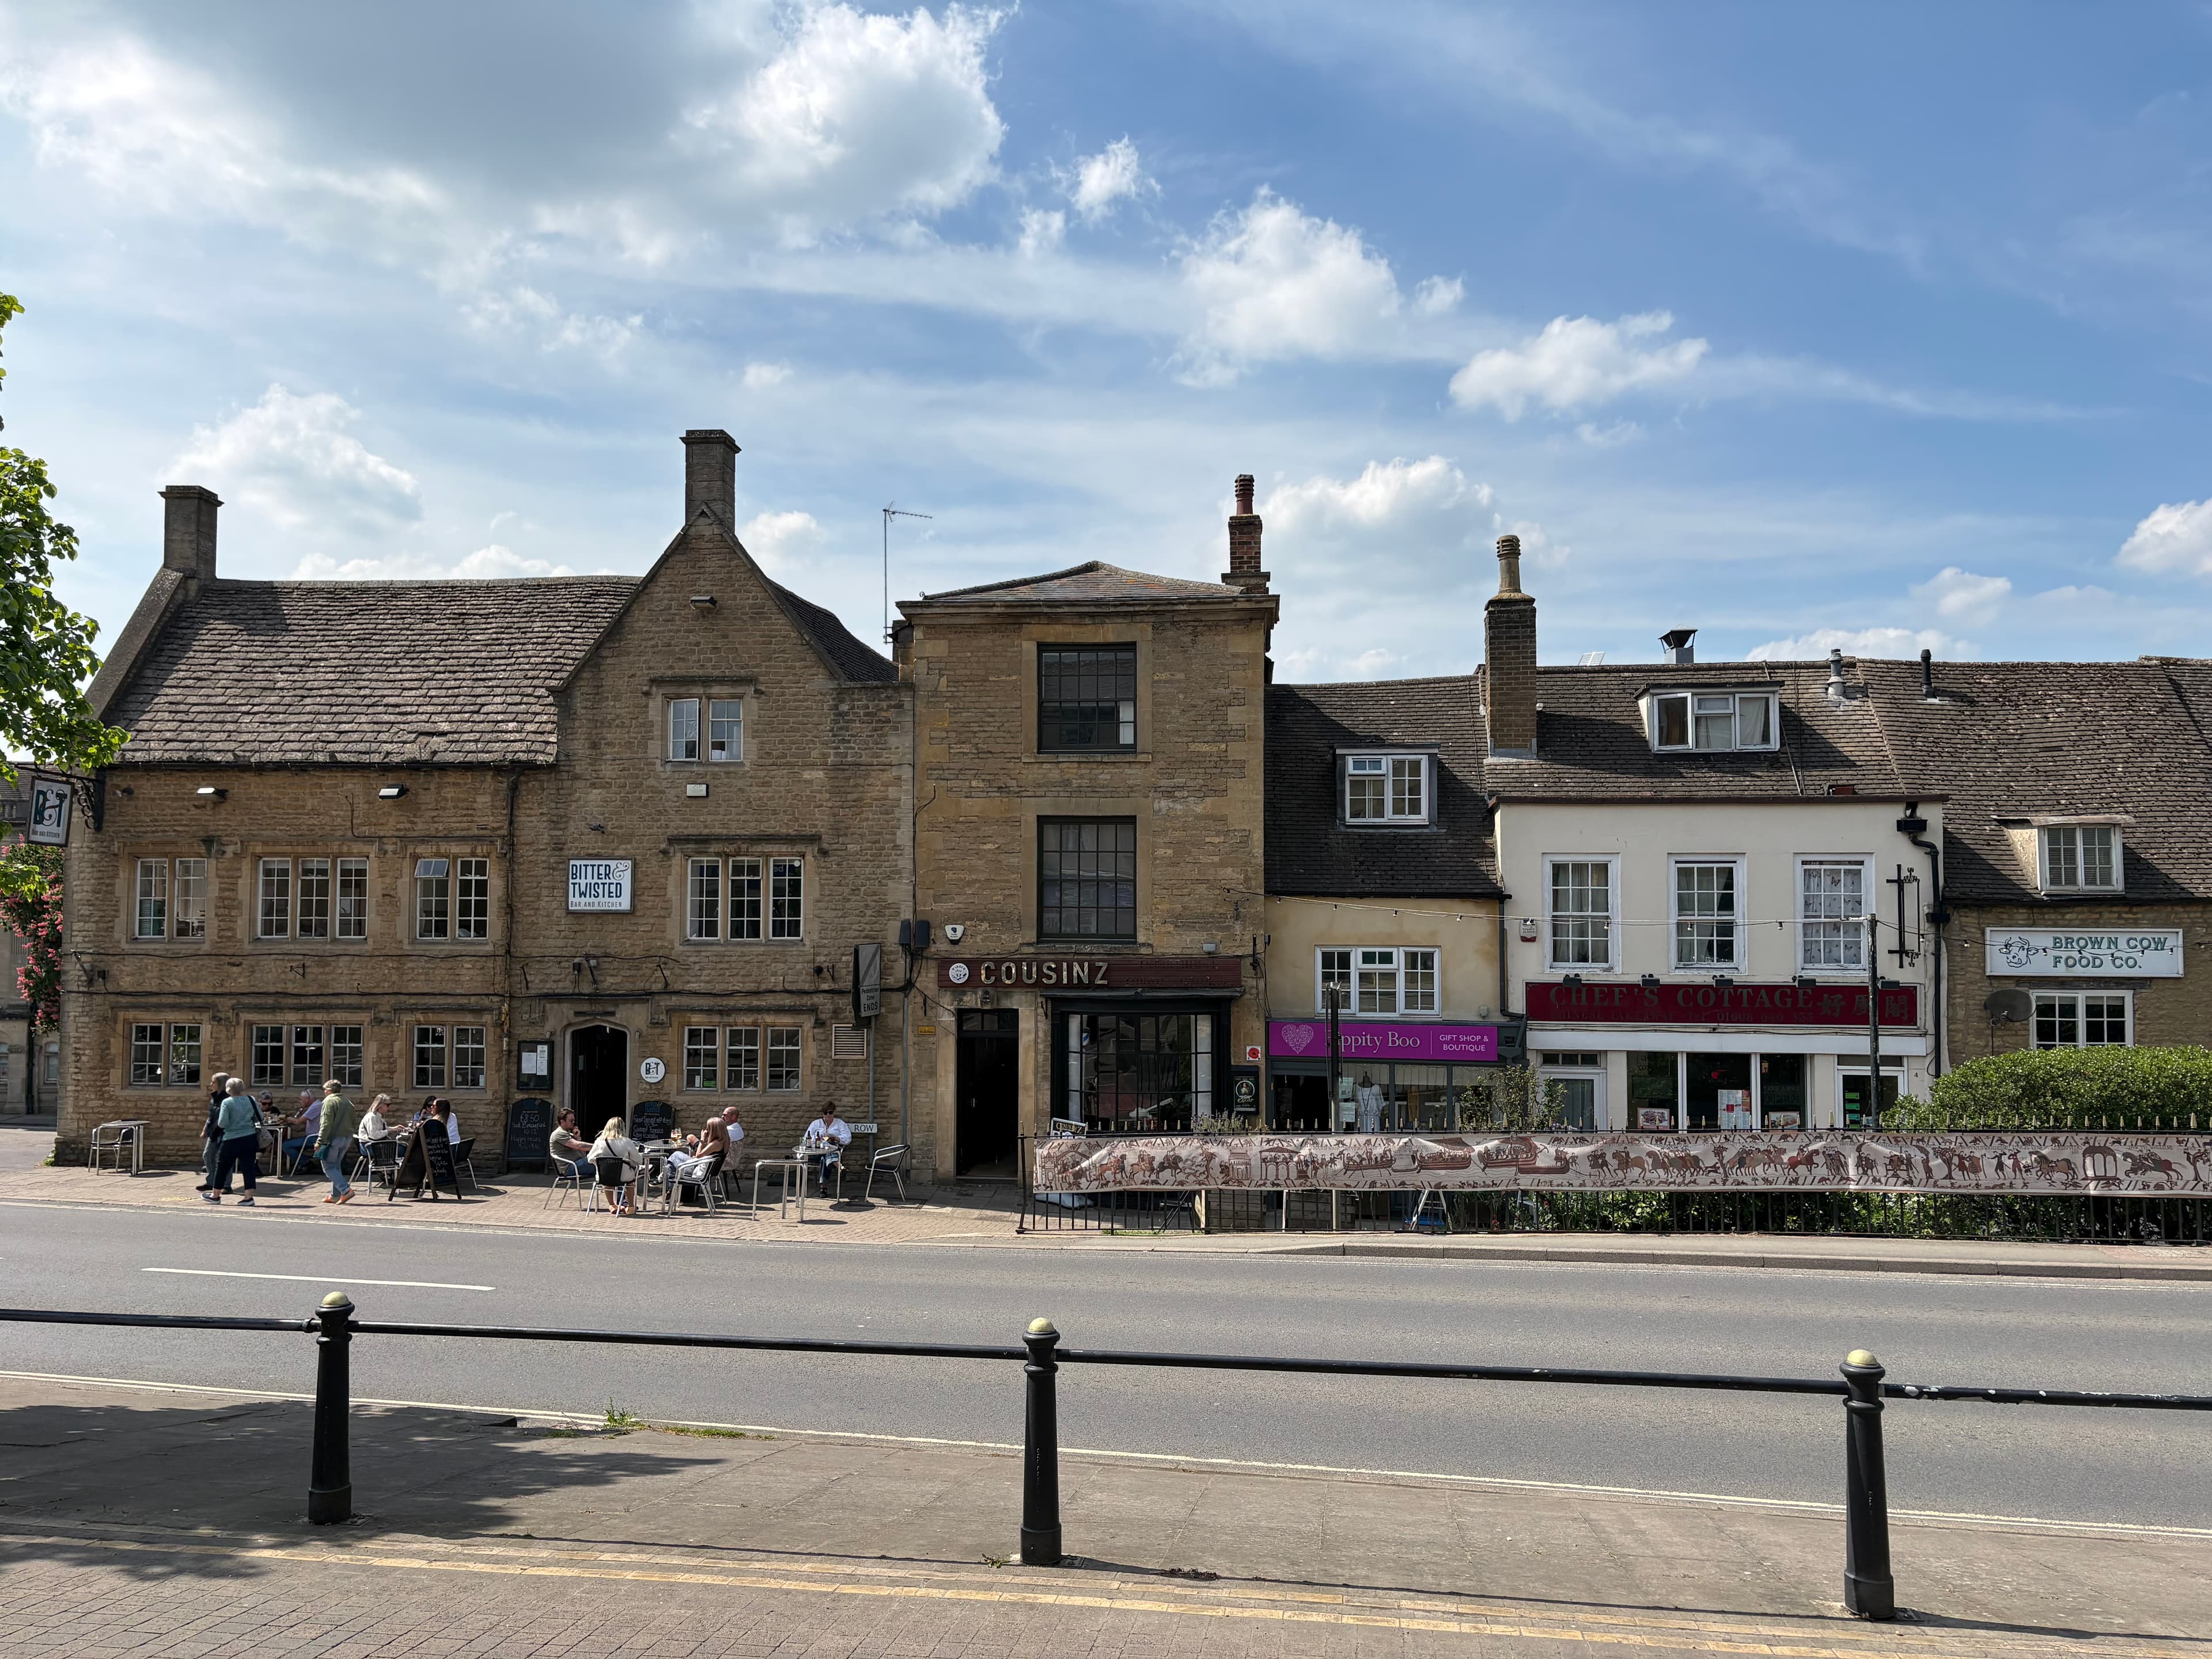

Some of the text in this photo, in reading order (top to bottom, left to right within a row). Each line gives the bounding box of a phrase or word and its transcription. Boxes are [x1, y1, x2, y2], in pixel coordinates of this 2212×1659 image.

[571, 864, 611, 880] BITTER
[571, 882, 622, 899] TWISTED
[597, 900, 622, 908] KITCHEN
[2052, 936, 2168, 950] BROWN COW
[2052, 956, 2142, 969] FOOD CO.
[980, 961, 1108, 984] COUSINZ
[1550, 986, 1813, 1008] CHEF'S COTTAGE
[863, 1002, 878, 1012] ENDS
[1387, 1031, 1421, 1047] Boo
[1442, 1044, 1486, 1052] BOUTIQUE
[854, 1124, 874, 1132] ROW
